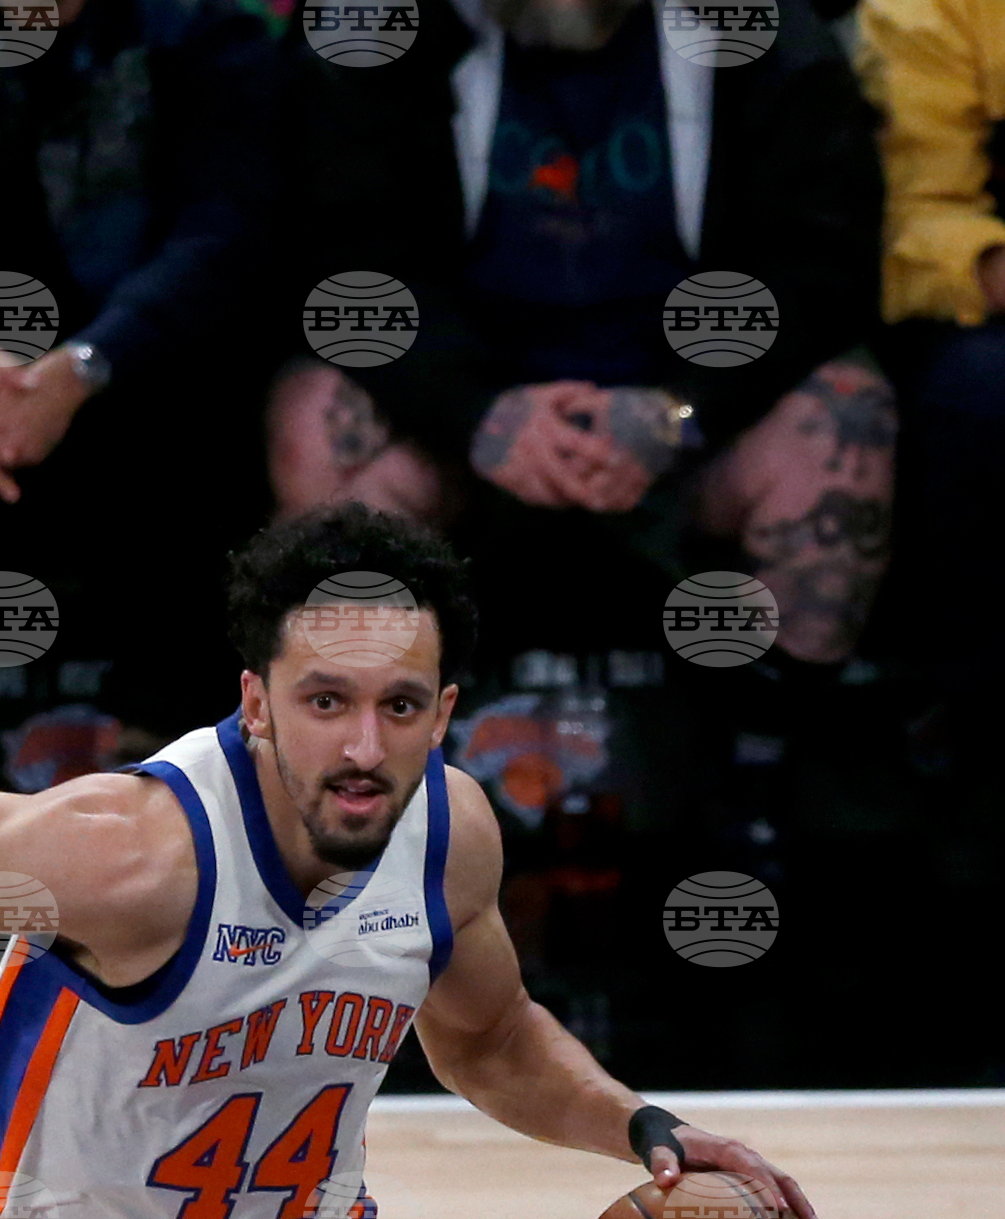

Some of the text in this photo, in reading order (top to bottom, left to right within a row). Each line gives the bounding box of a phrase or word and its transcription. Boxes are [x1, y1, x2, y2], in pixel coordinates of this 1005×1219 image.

[213, 923, 286, 966] NYC
[358, 911, 419, 935] abu dhabi
[137, 998, 288, 1088] NEW
